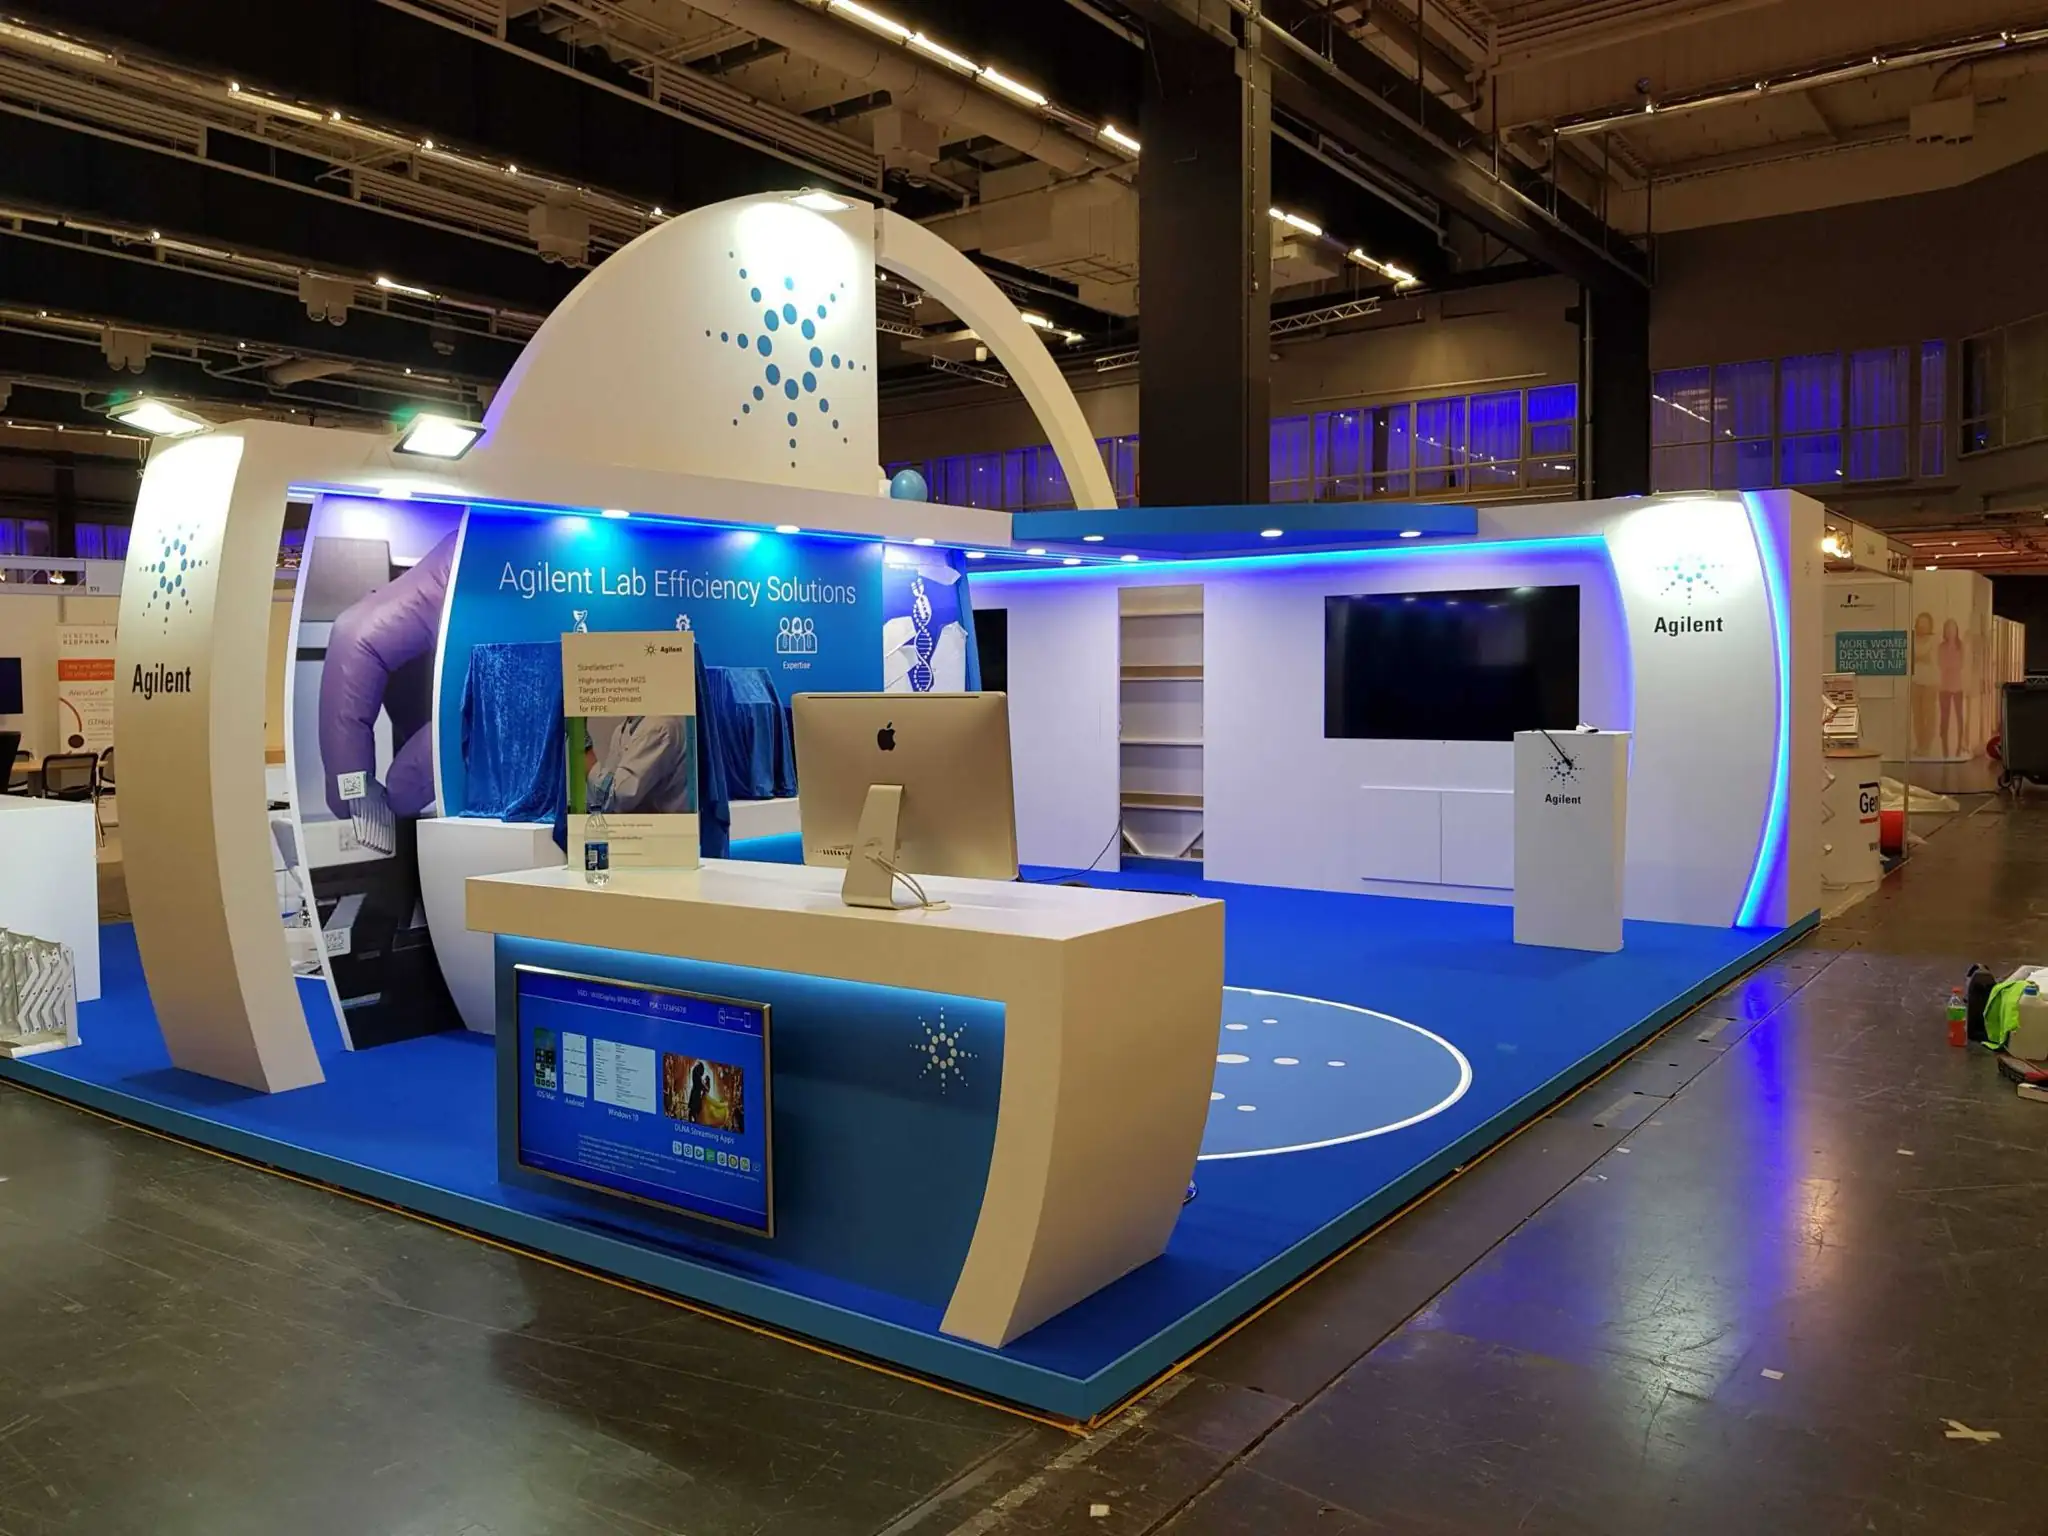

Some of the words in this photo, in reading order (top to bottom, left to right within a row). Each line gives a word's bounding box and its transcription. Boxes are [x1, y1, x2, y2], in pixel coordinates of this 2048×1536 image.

[499, 561, 593, 599] Agilent
[600, 566, 647, 597] Lab
[654, 569, 761, 607] Efficiency
[767, 575, 857, 605] Solutions
[1653, 616, 1724, 637] Agilent
[1840, 639, 1868, 648] MORE
[660, 646, 683, 654] Agilent
[1840, 649, 1888, 660] DESERVE
[1840, 659, 1868, 670] RIGHT
[1872, 659, 1885, 669] TO
[132, 663, 192, 701] Agilent
[579, 686, 600, 694] Target
[1545, 793, 1582, 806] Agilent
[607, 1108, 632, 1120] Windows
[691, 1127, 719, 1142] Streaming
[720, 1134, 735, 1144] Apps
